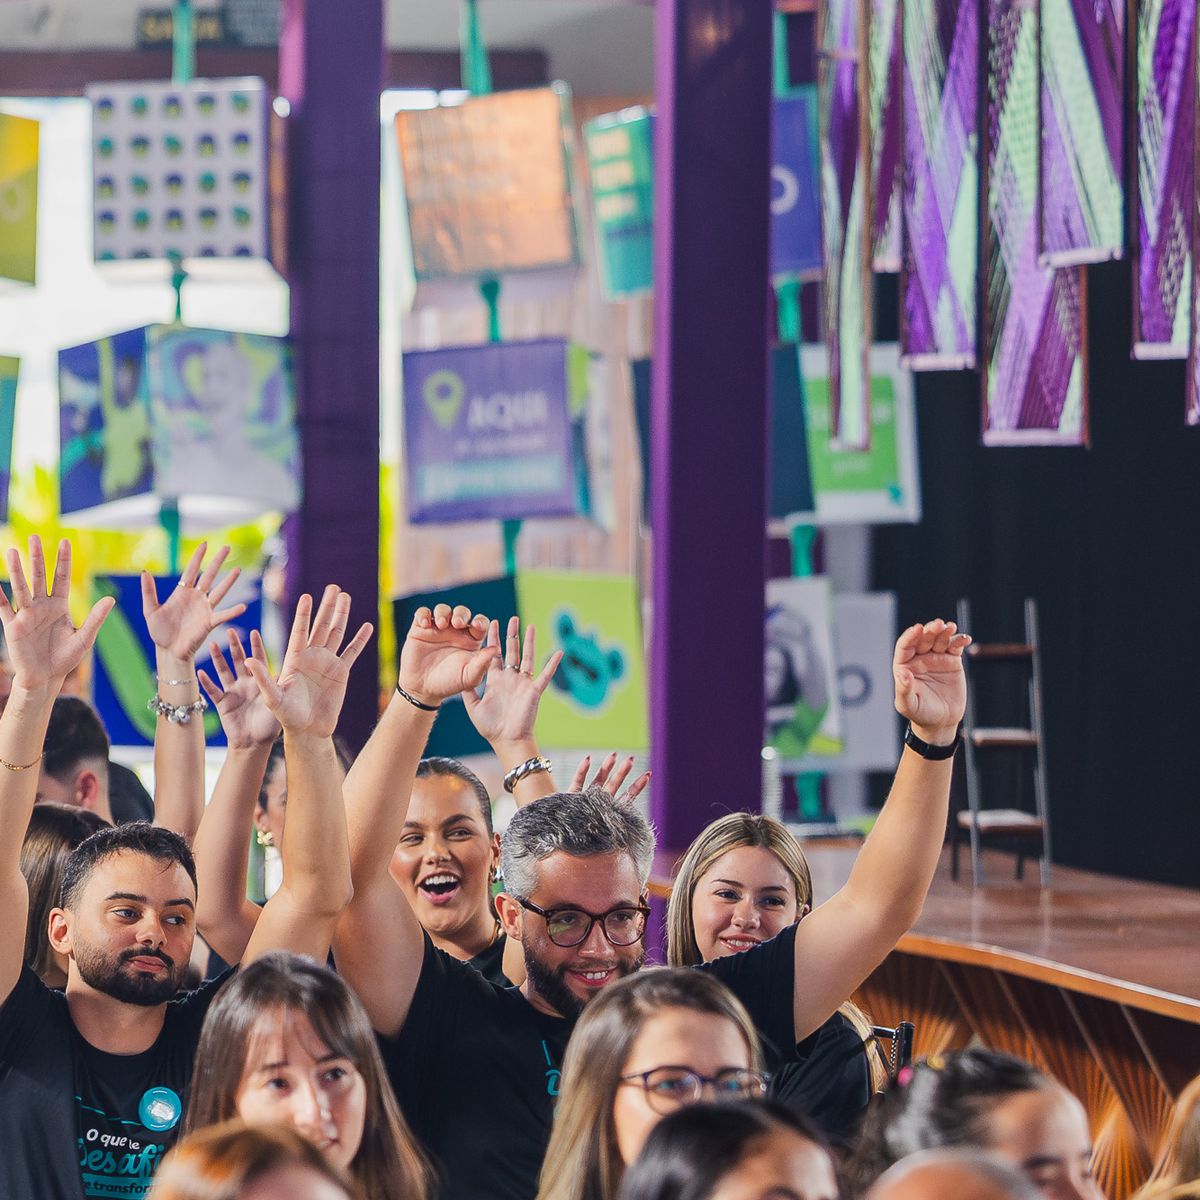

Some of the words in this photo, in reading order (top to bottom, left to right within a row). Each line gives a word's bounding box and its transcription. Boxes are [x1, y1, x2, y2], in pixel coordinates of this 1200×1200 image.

[86, 1128, 99, 1141] O
[100, 1134, 128, 1147] que
[94, 1181, 152, 1194] transfor
